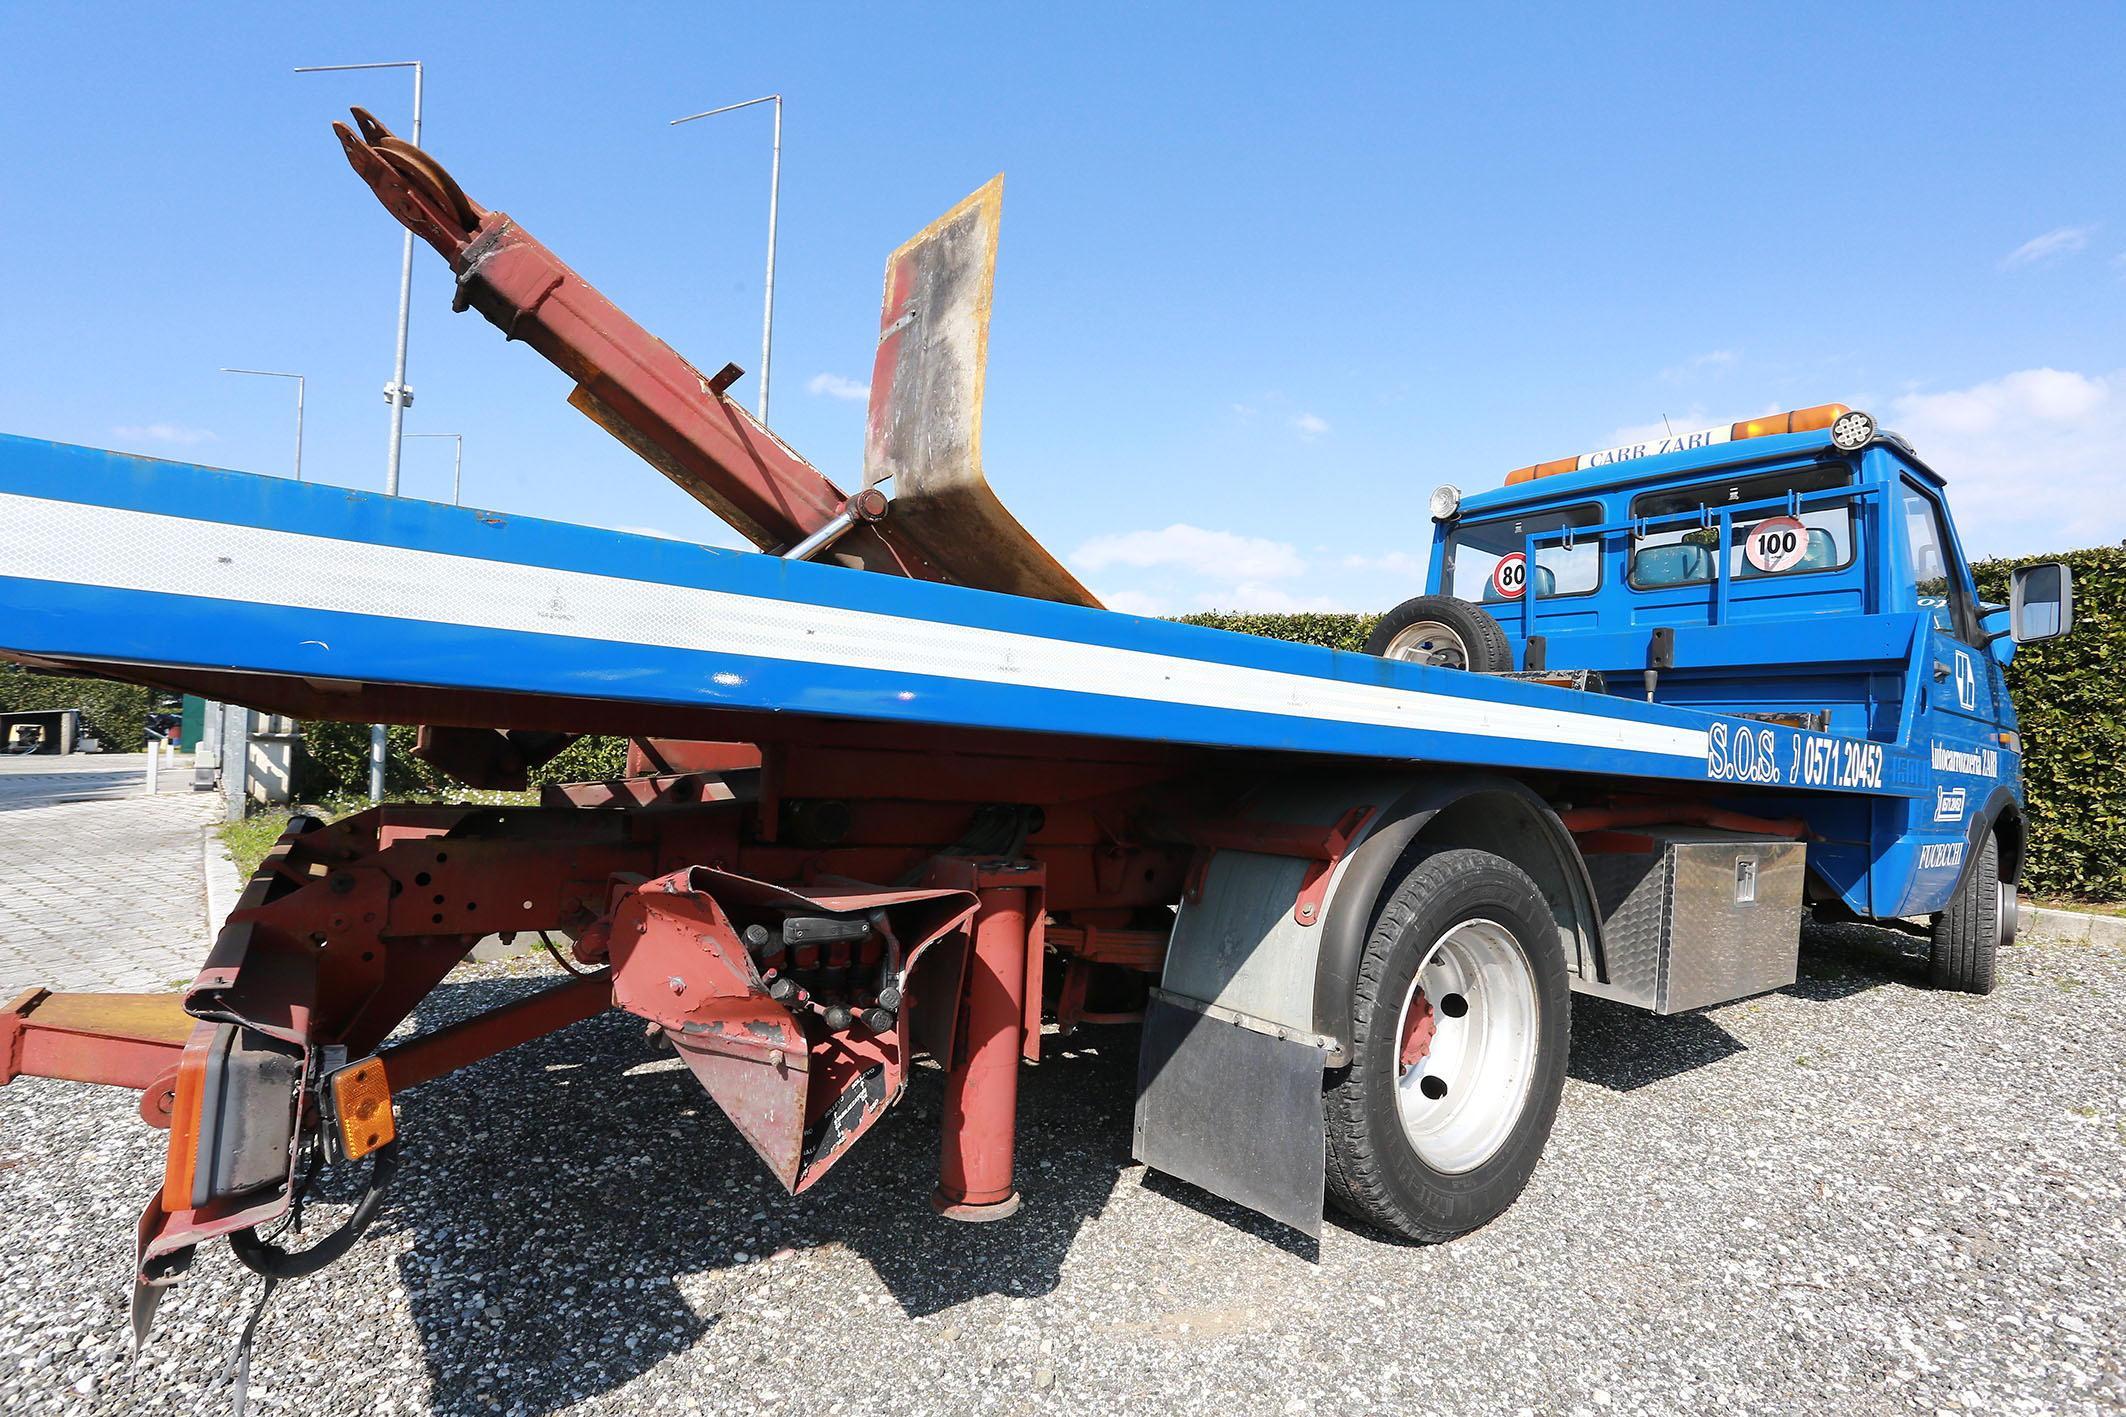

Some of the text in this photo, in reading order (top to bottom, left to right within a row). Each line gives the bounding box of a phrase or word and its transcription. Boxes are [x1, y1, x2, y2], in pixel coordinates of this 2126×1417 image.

[1657, 431, 1712, 455] ZARI
[1758, 531, 1797, 556] 100
[1502, 564, 1526, 587] 80
[1707, 721, 1883, 789] S.O.S. 0571.20452
[1982, 748, 1998, 778] ZARI
[1918, 842, 1964, 870] FUCECCHI
